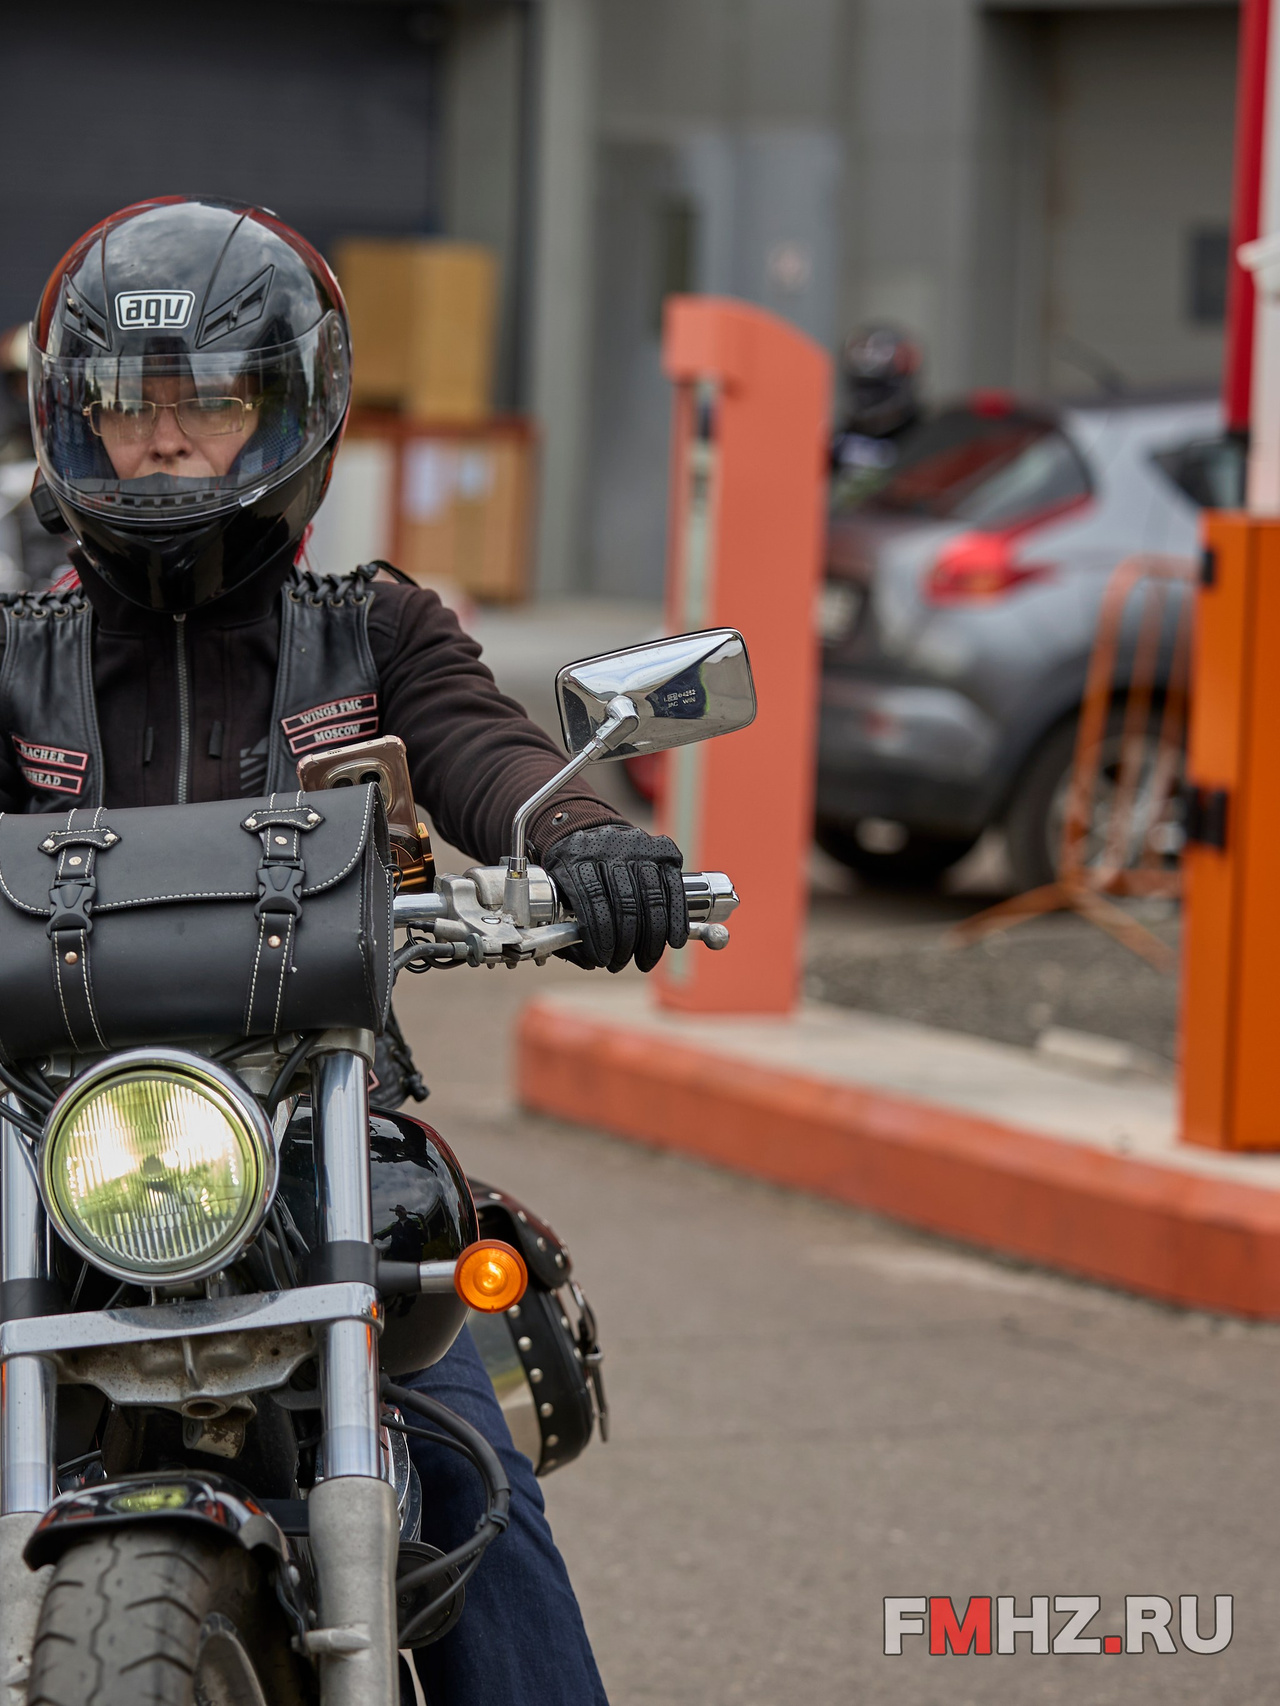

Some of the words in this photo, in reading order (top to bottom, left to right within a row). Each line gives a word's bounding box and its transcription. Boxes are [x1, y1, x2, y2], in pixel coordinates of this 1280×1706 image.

[126, 298, 185, 327] agv
[339, 699, 362, 714] FMC
[314, 724, 361, 742] MOSCOW
